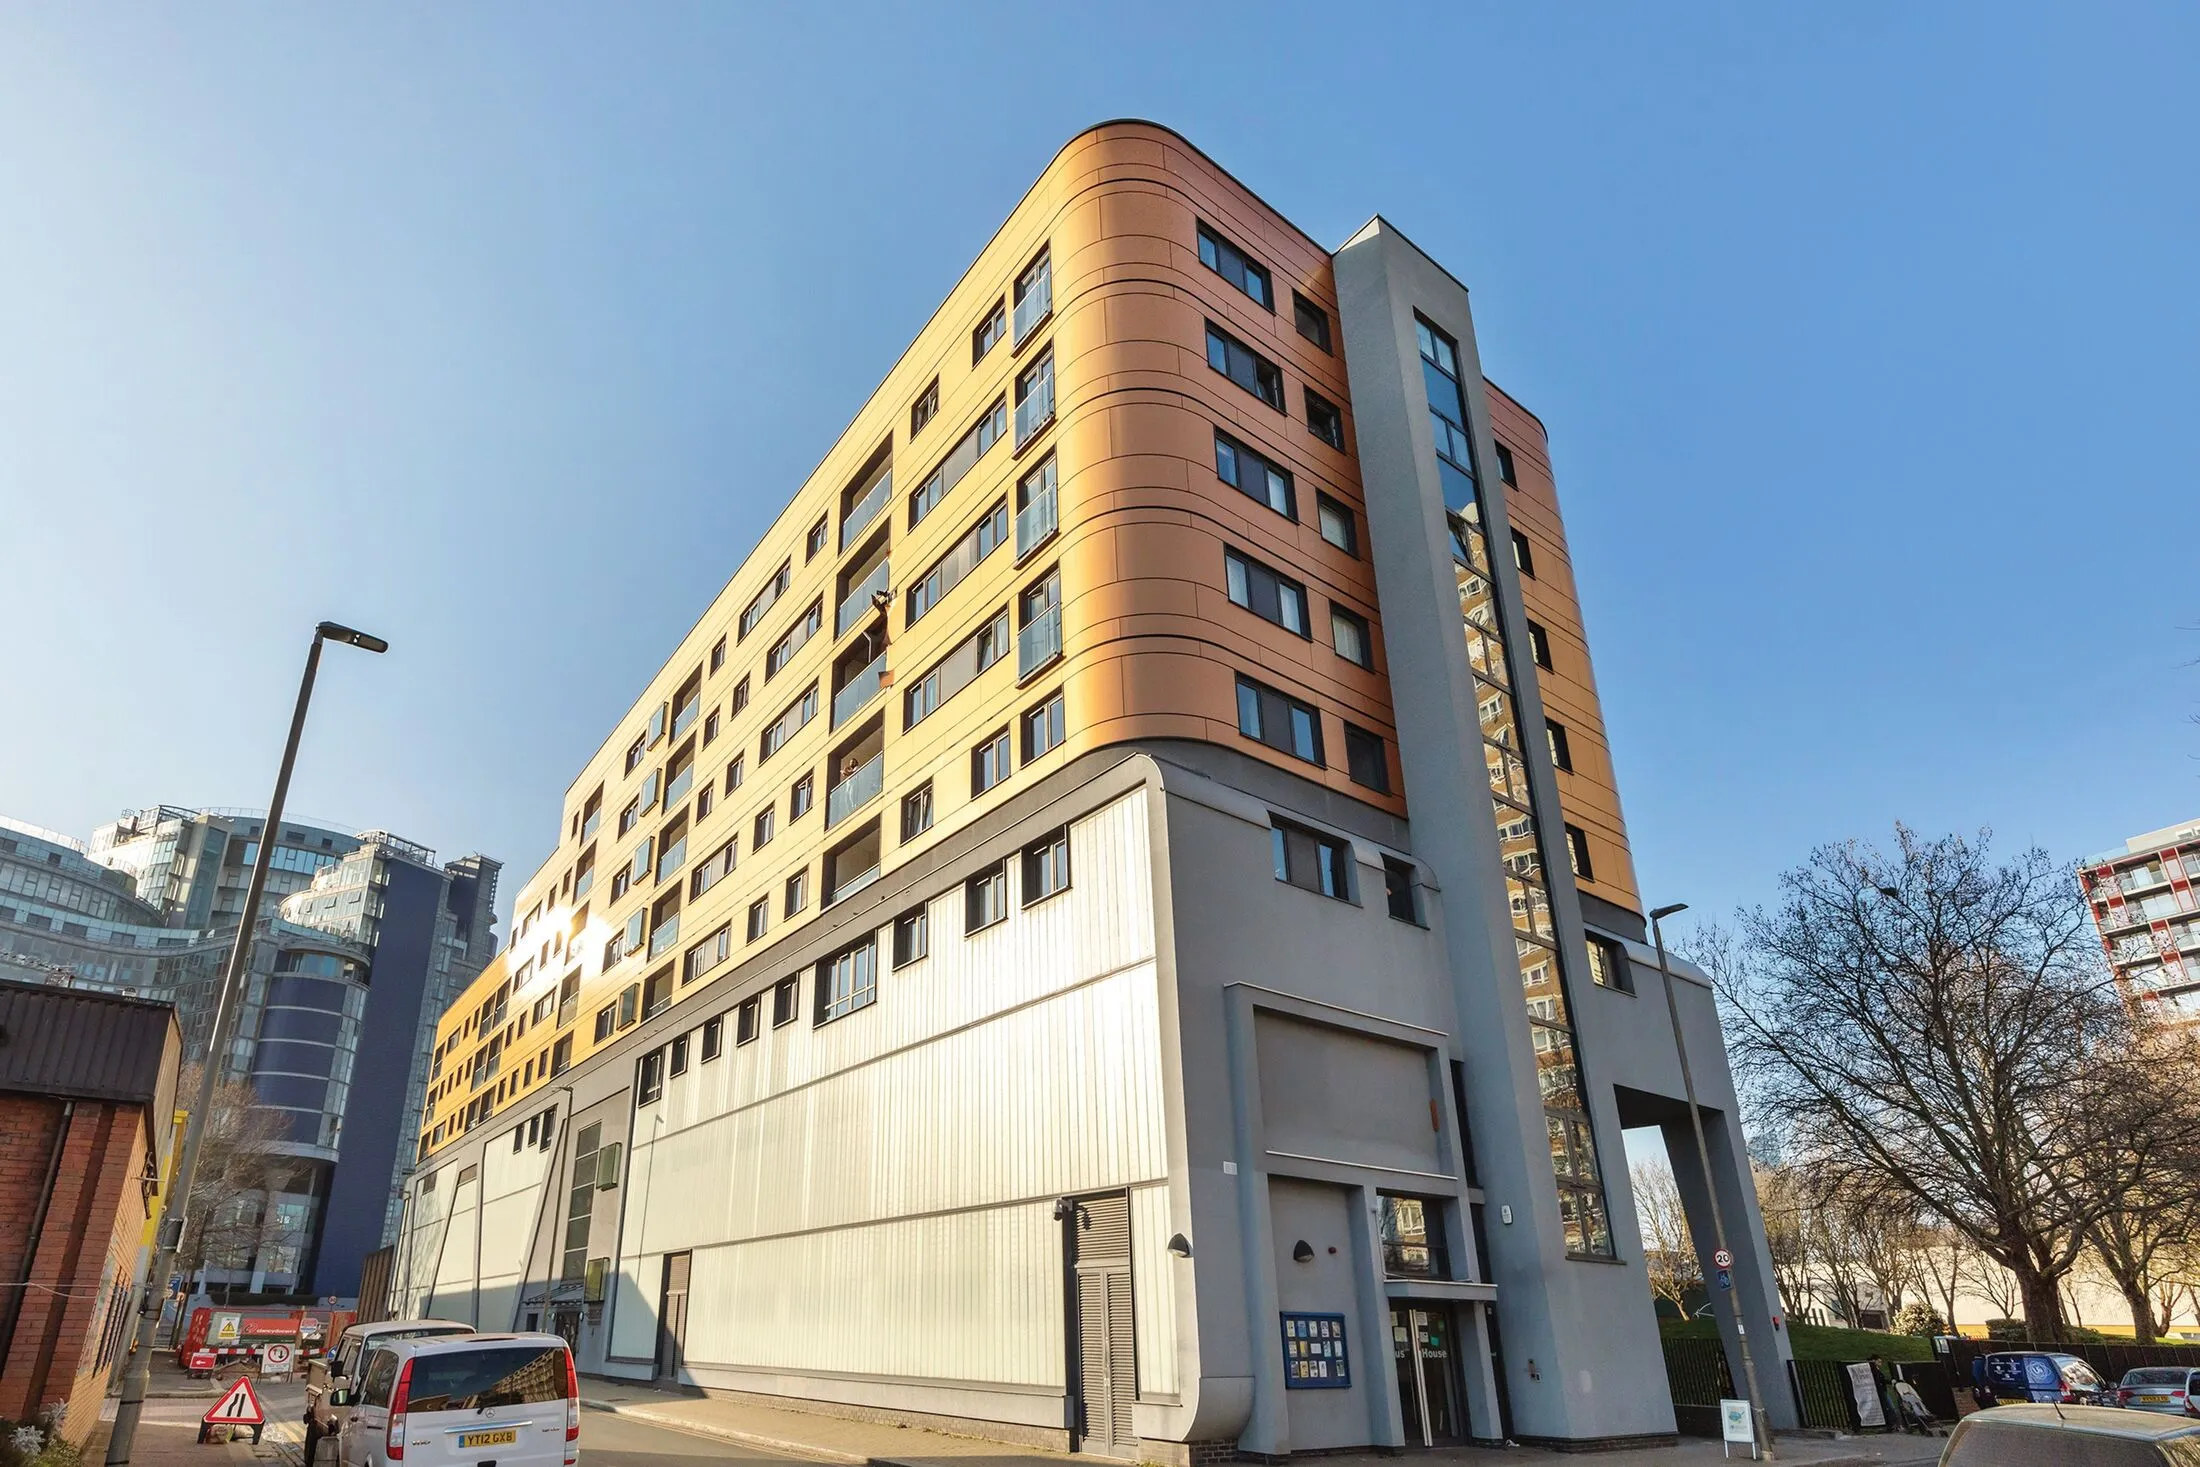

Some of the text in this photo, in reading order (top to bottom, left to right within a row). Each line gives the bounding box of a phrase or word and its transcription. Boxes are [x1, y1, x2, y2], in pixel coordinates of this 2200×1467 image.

[1716, 1254, 1729, 1262] 20
[1422, 1348, 1447, 1358] House
[468, 1432, 512, 1445] YT12 GXB
